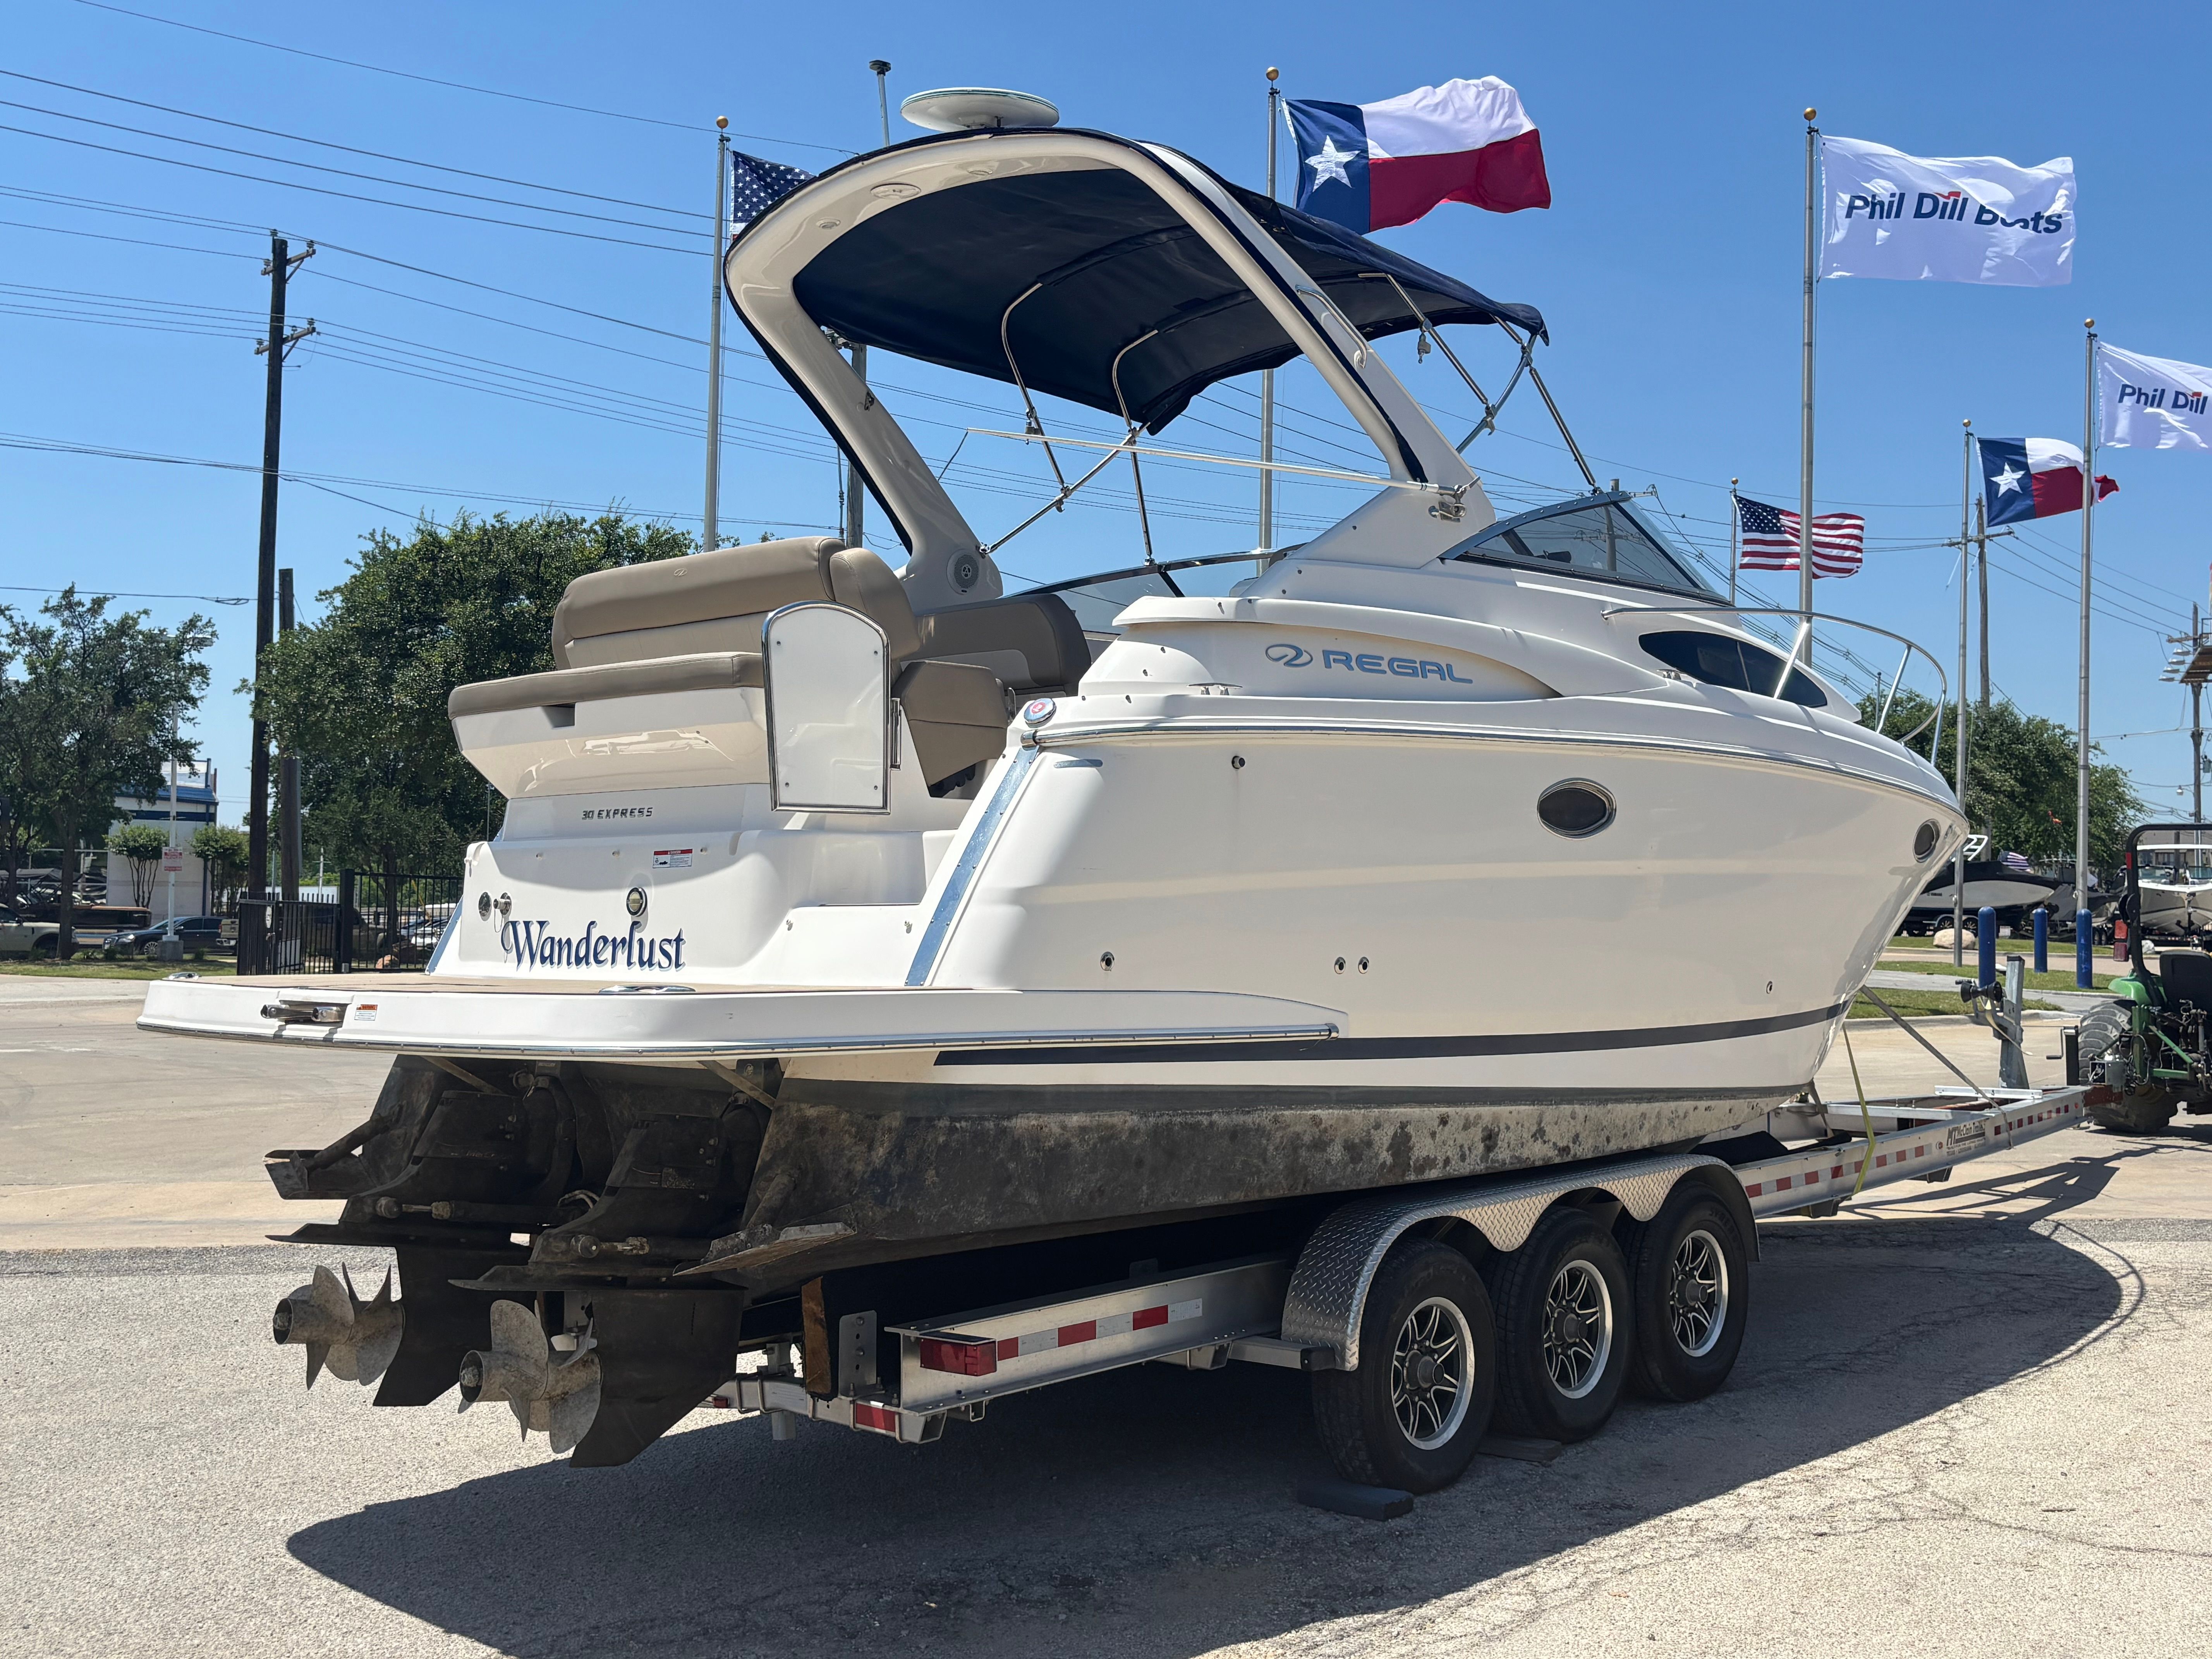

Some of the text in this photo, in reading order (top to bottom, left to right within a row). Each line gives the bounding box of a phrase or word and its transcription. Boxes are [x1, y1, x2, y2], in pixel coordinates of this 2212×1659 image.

[1845, 192, 1905, 220] Phil
[1913, 192, 1968, 221] Dill
[2118, 384, 2208, 415] Phil Dill
[1322, 649, 1473, 684] REGAL
[582, 807, 653, 820] 30 EXPRESS
[501, 921, 686, 972] Wanderlust
